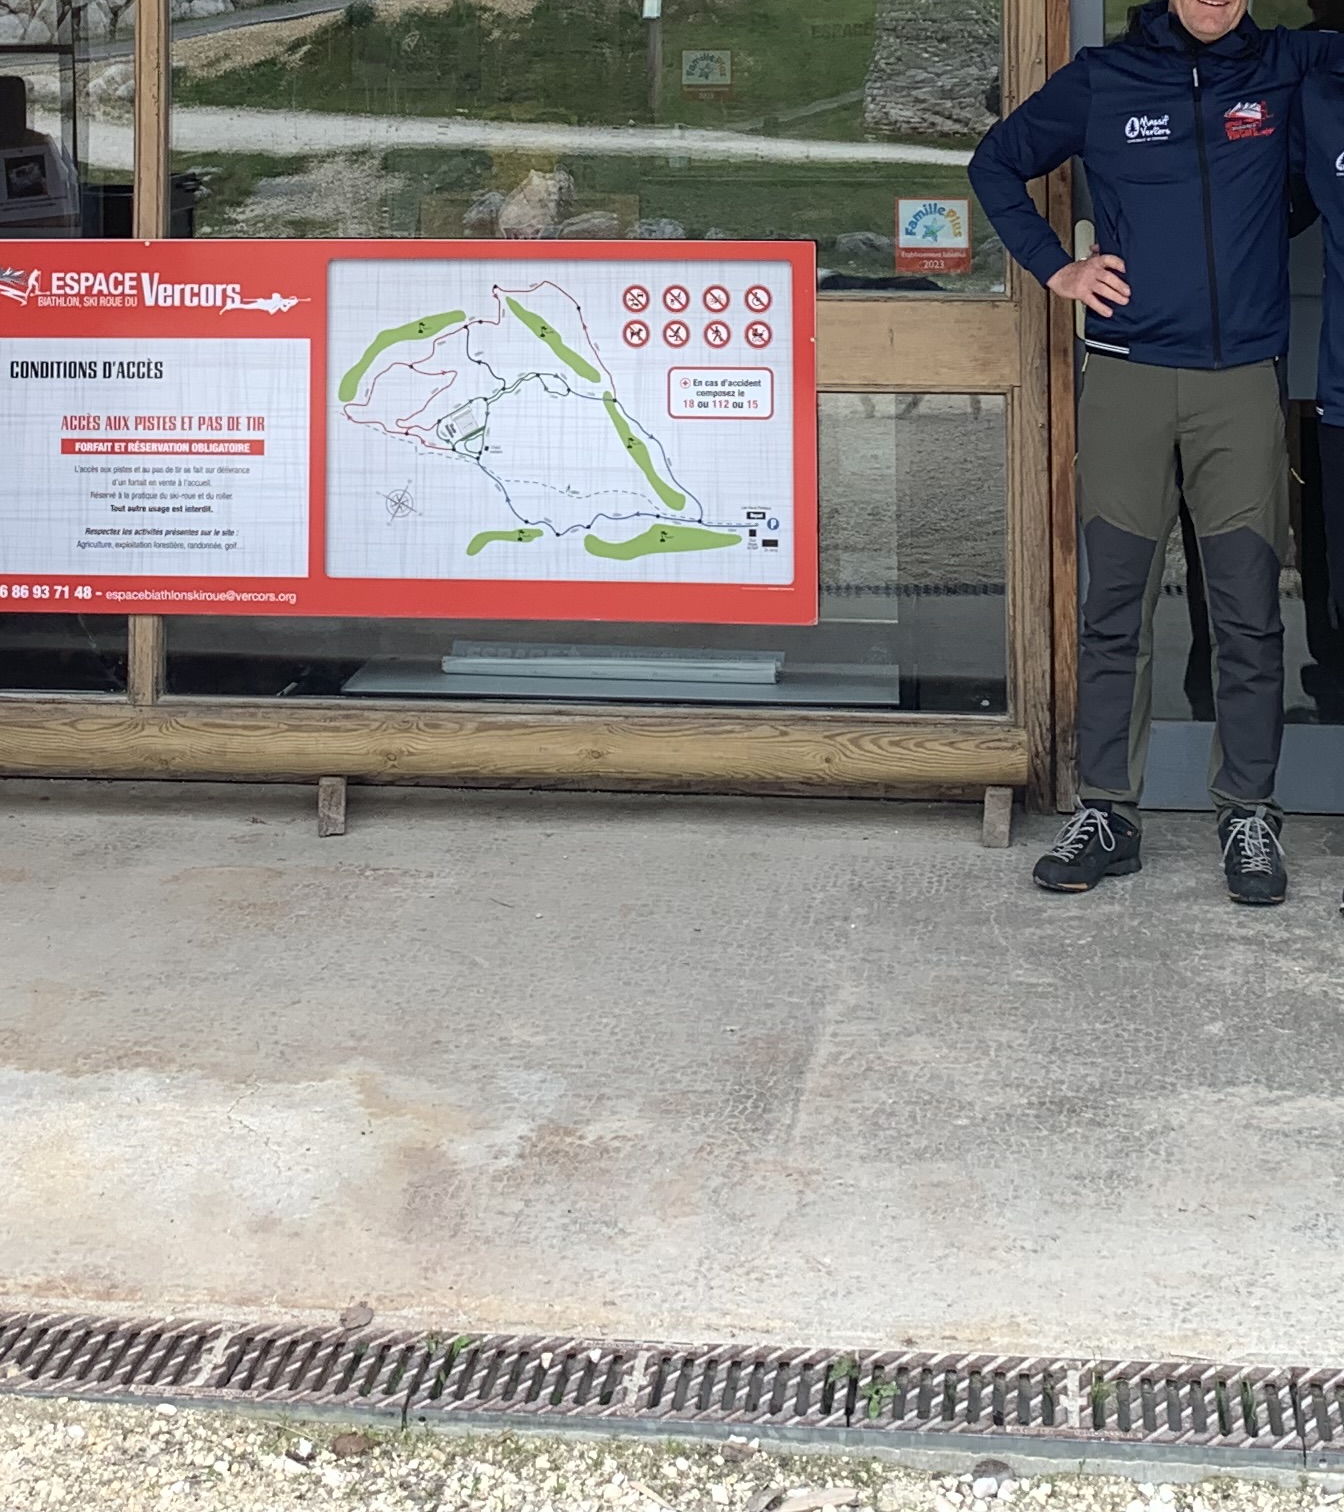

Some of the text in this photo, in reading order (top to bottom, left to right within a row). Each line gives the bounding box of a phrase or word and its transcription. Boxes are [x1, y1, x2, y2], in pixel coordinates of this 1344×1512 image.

[905, 203, 946, 236] Famille
[923, 260, 945, 269] 2023
[52, 272, 240, 307] ESPACE Vercors
[38, 296, 137, 308] BIATHLON, SKI ROUE DU
[10, 358, 163, 379] CONDITIONS D'ACCÈS
[693, 379, 703, 387] En
[720, 379, 762, 387] d'accident
[696, 389, 745, 398] composez le
[683, 399, 695, 408] 18
[712, 399, 730, 408] 112
[747, 400, 759, 409] 15
[61, 413, 265, 431] ACCÈS AUX PISTES ET PAS DE TIR
[75, 440, 250, 453] FORFAIT ET RÉSERVATION OBLIGATOIRE
[11, 585, 29, 598] 86
[32, 585, 49, 598] 93
[54, 585, 70, 598] 71
[74, 586, 92, 599] 48
[106, 589, 297, 604] espacebiathlonskiroue@vercors.org
